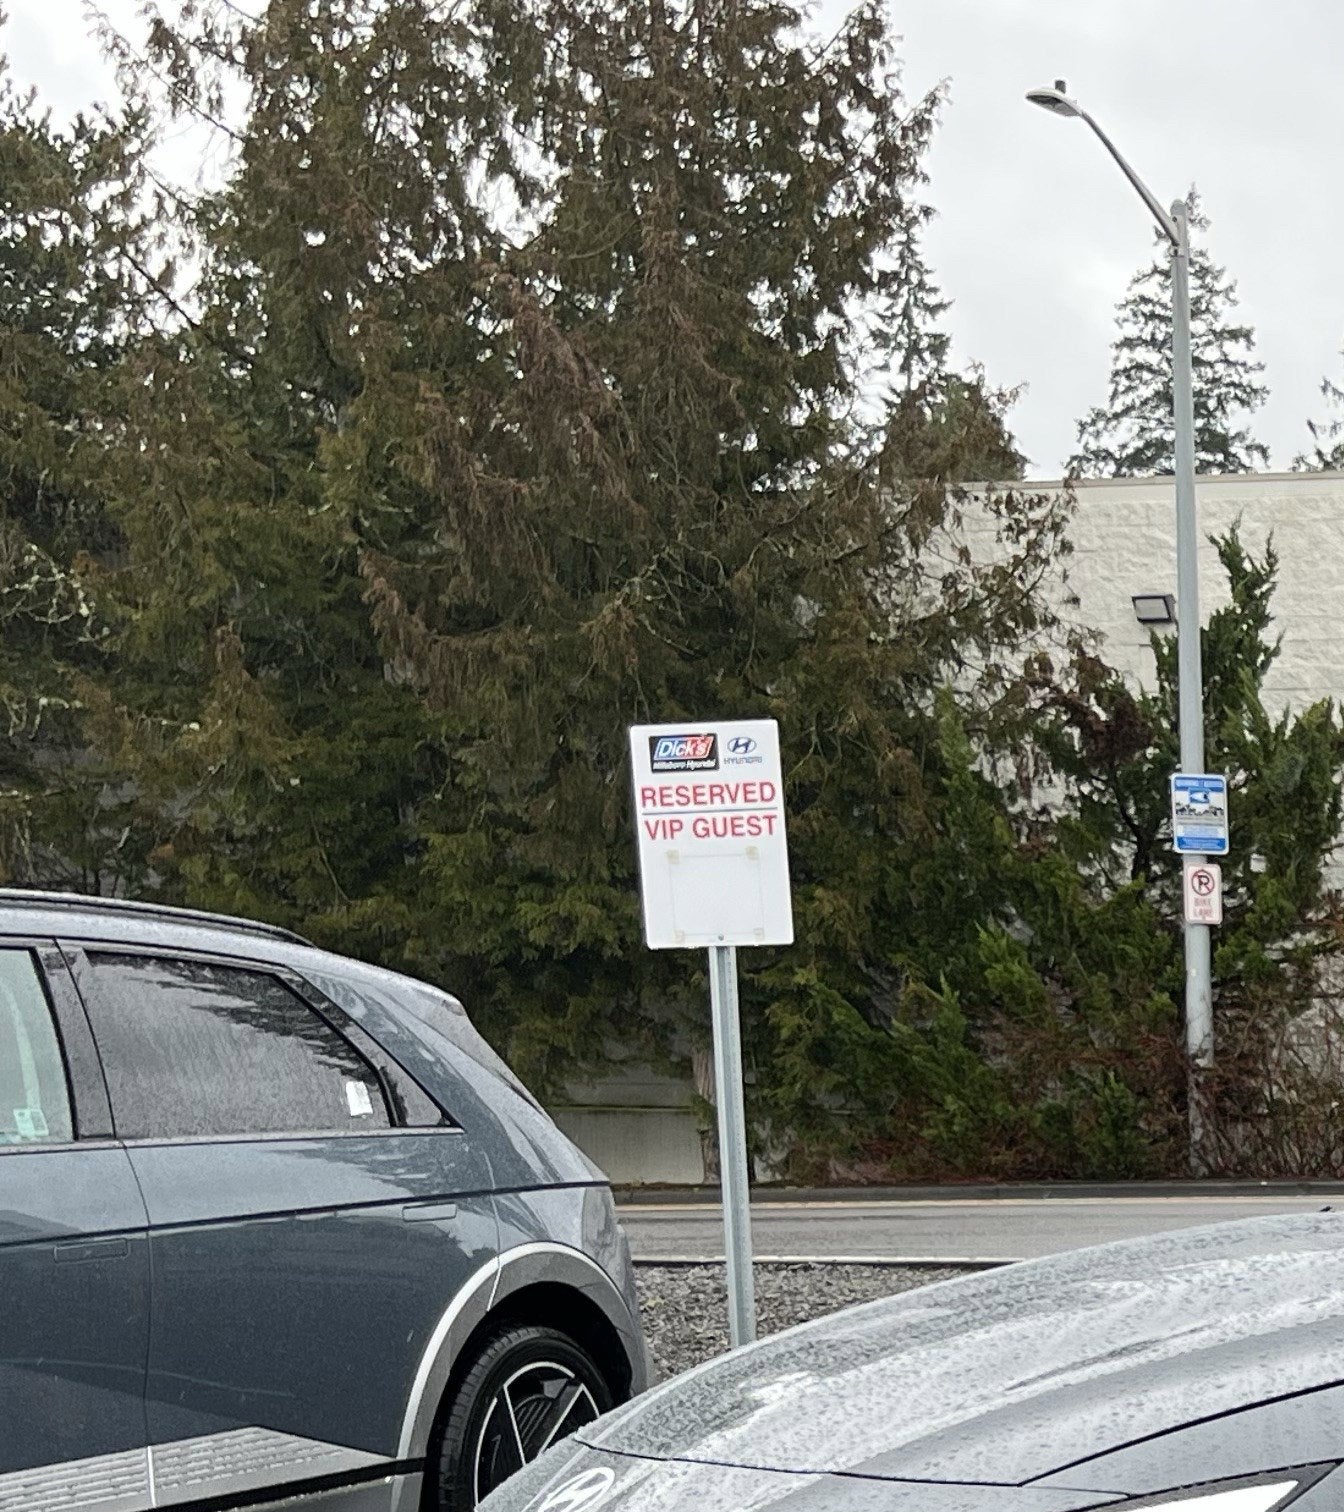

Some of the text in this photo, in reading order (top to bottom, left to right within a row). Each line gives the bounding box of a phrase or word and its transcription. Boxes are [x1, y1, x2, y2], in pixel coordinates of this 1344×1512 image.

[640, 781, 776, 808] RESERVED
[644, 814, 778, 841] VIP GUEST
